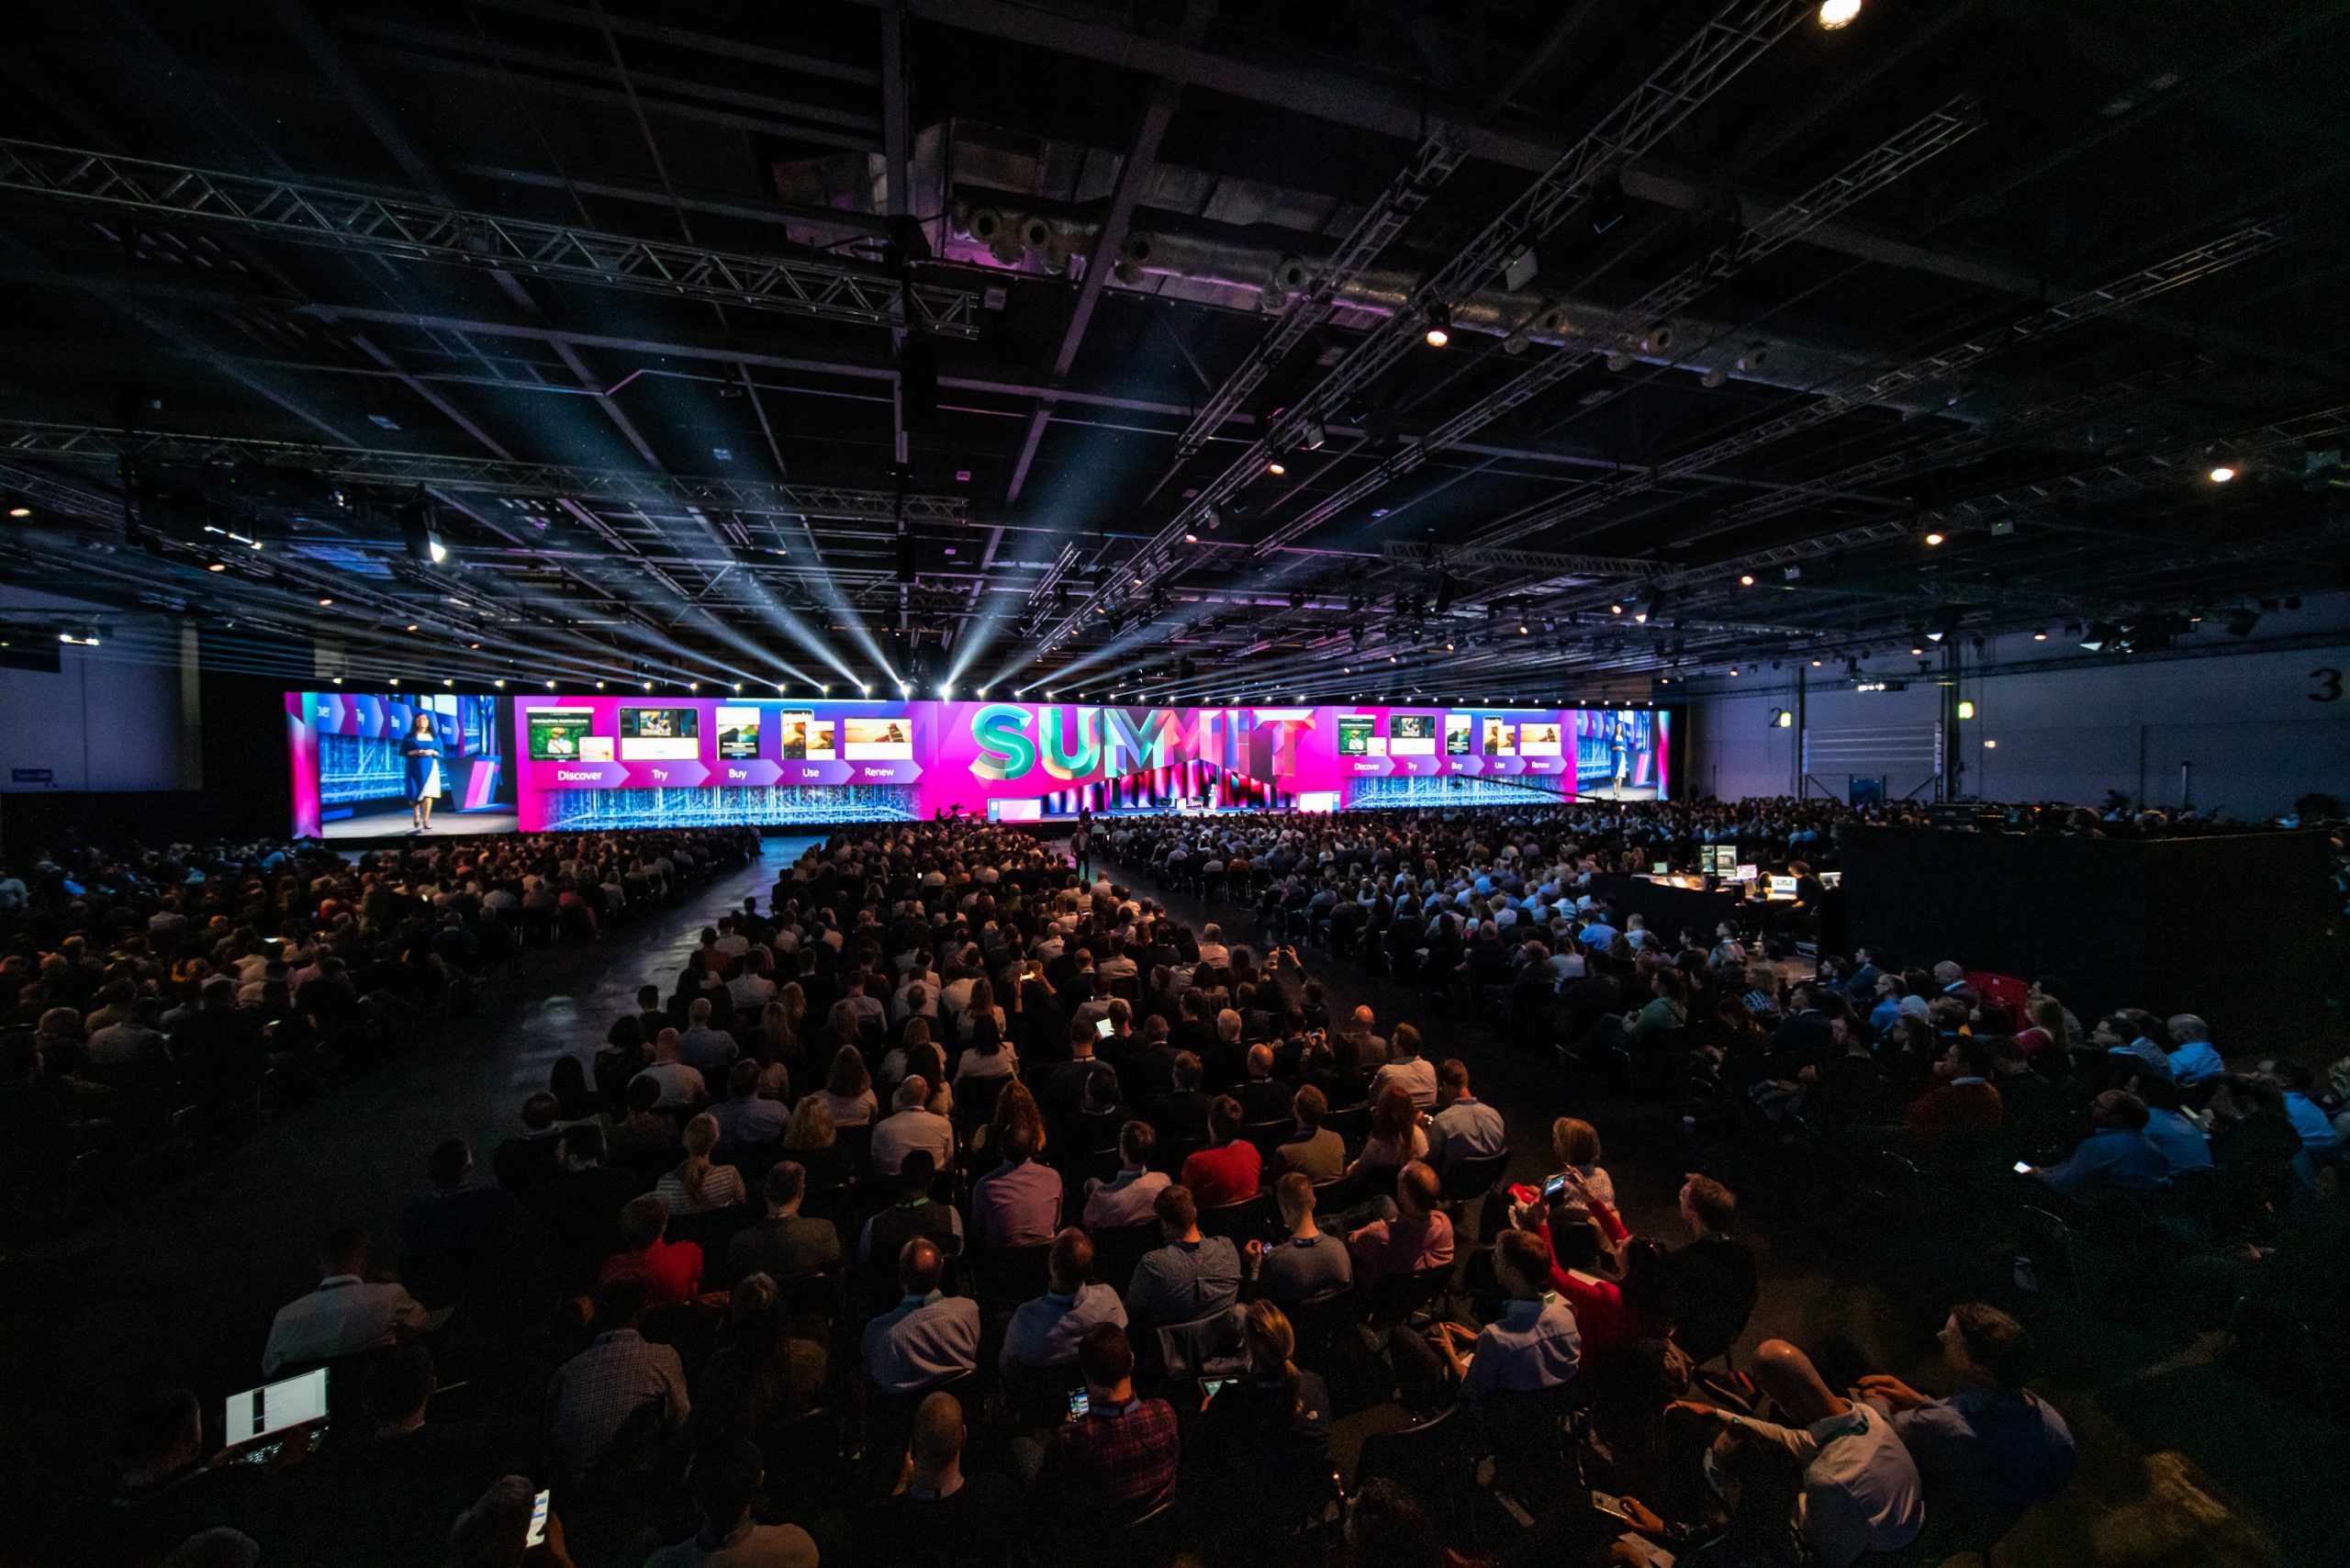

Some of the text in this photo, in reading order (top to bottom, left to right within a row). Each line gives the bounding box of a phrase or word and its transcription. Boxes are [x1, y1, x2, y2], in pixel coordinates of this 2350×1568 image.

[2308, 667, 2343, 702] 3
[968, 703, 1316, 780] SUMMIT
[1353, 762, 1380, 771] Discover
[1406, 762, 1417, 772] Try
[1451, 762, 1463, 771] Buy
[1494, 761, 1506, 770] Use
[1531, 761, 1550, 769] Renew
[557, 769, 603, 781] Discover
[651, 768, 668, 781] Try
[728, 768, 747, 780] Buy
[801, 767, 820, 778] Use
[865, 767, 895, 778] Renew
